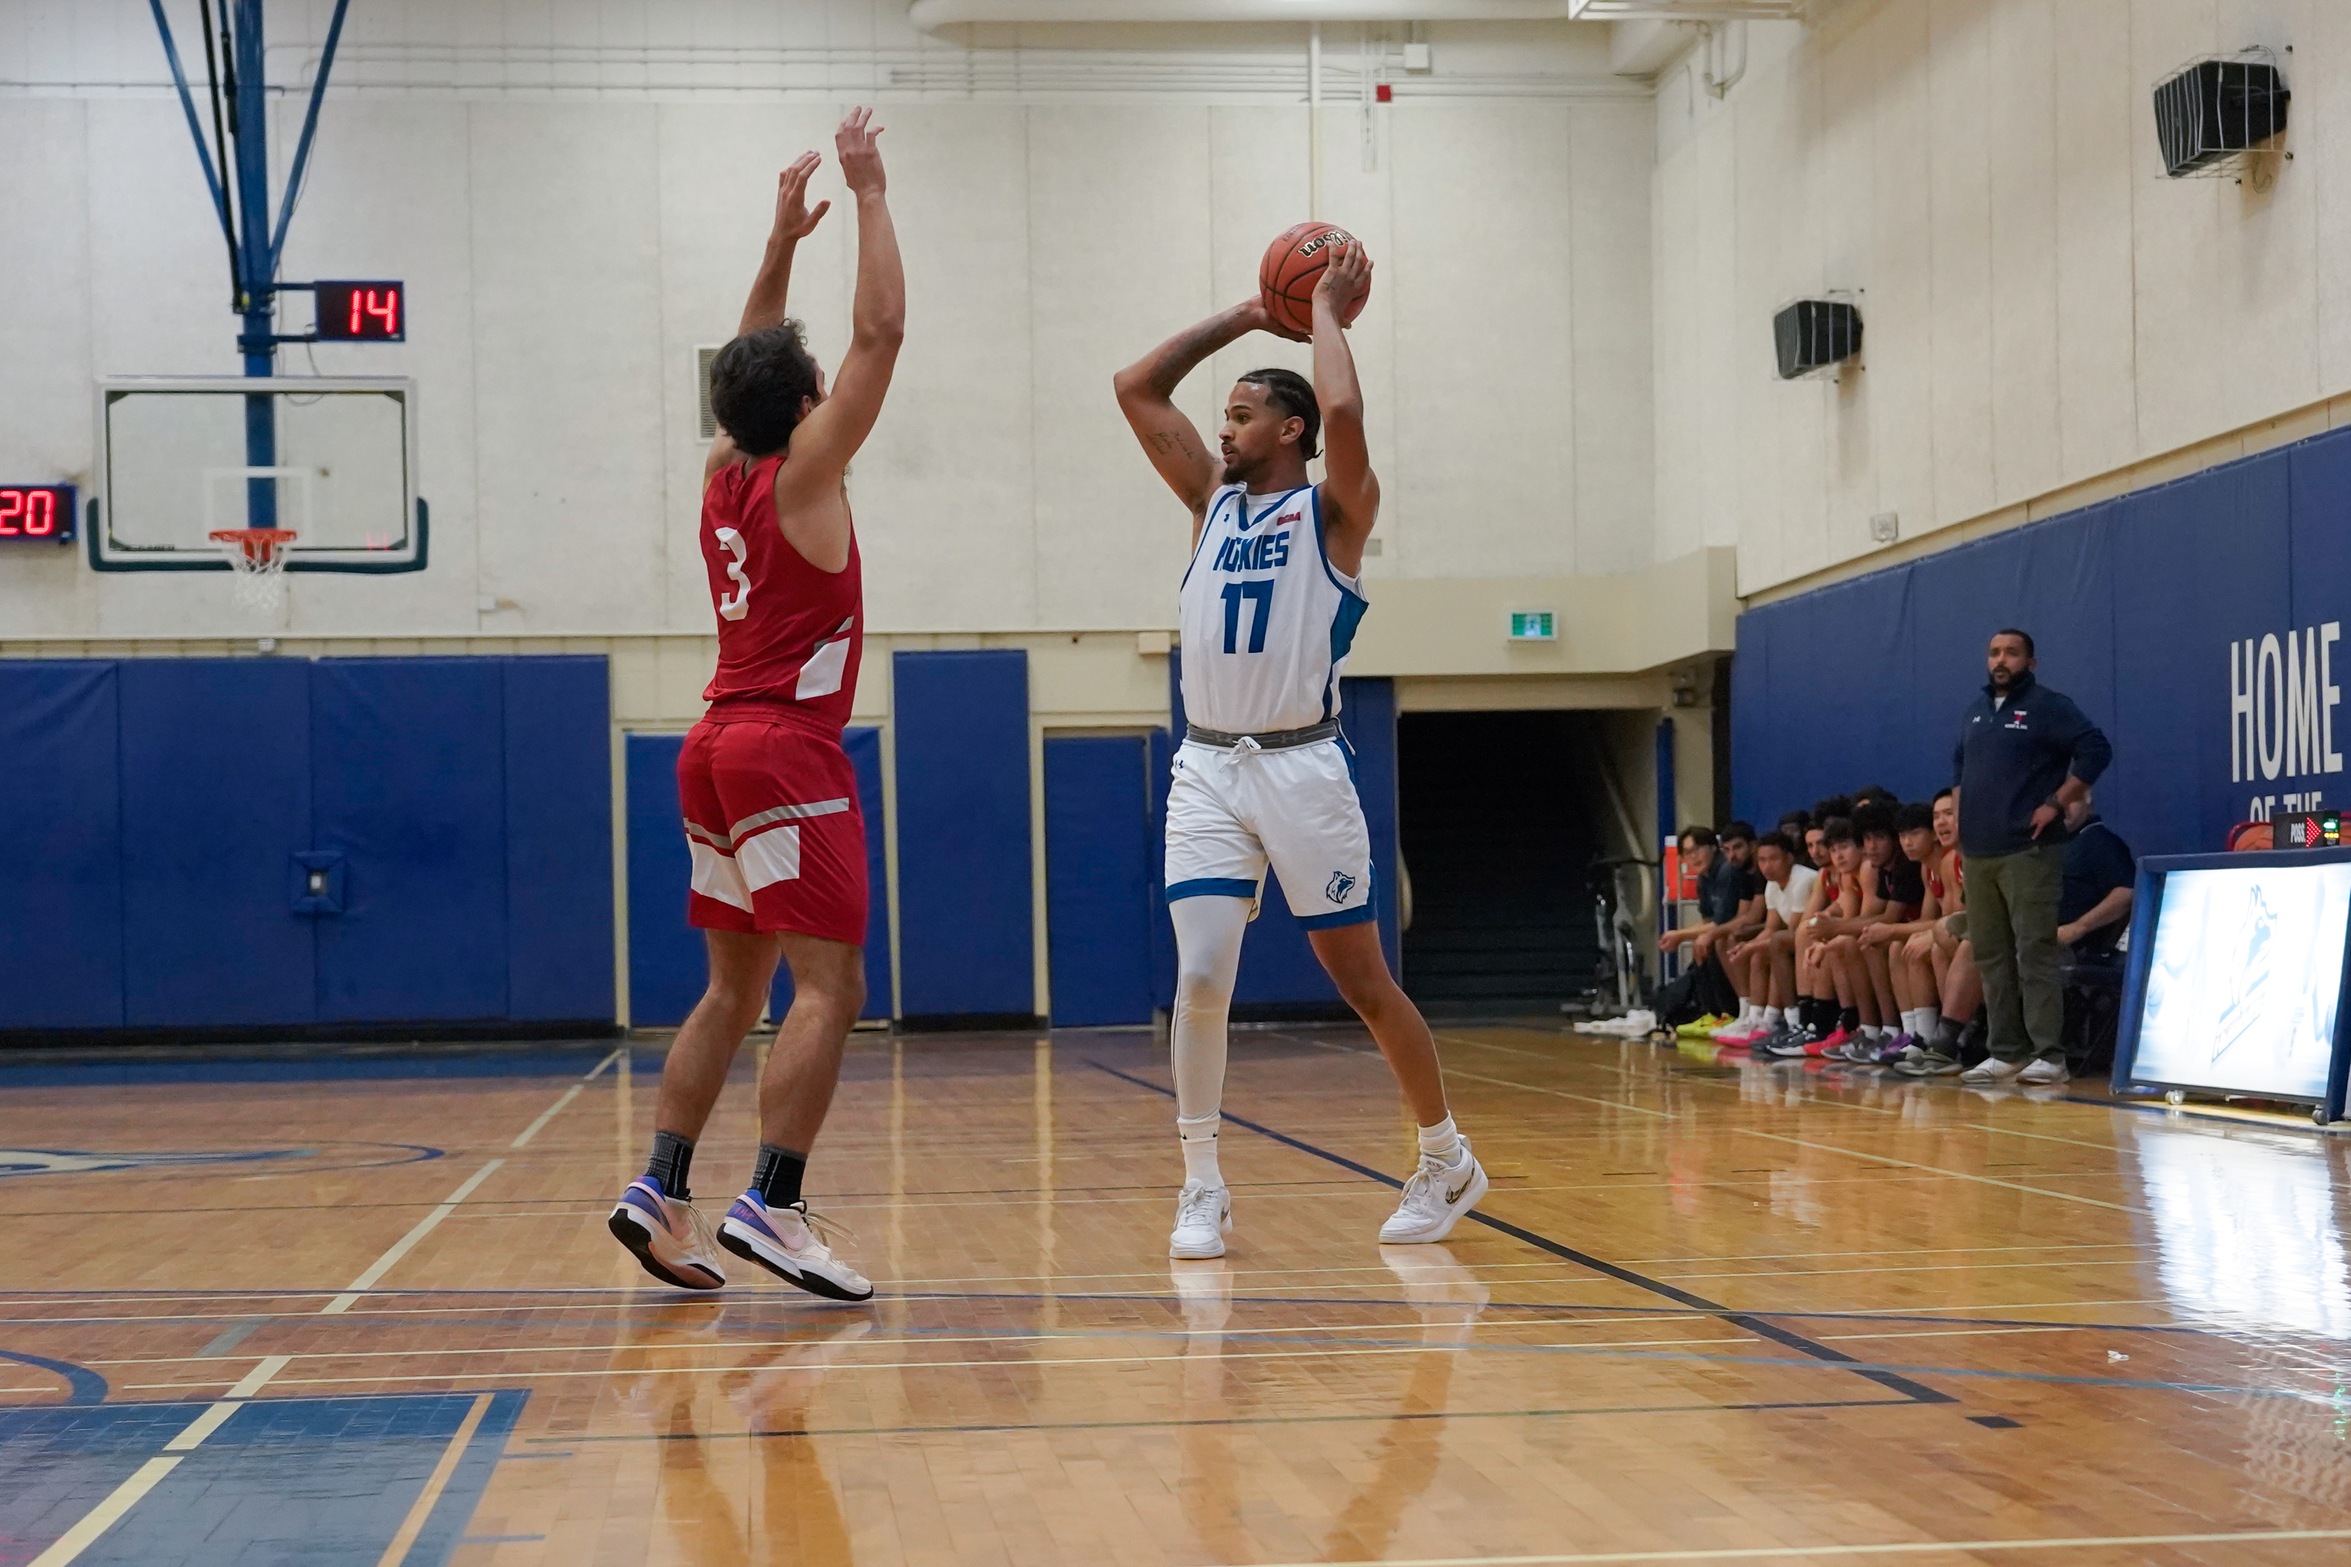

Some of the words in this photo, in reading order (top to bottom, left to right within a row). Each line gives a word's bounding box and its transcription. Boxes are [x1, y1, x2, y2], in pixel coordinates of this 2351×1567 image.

[1297, 230, 1356, 258] ilson
[350, 289, 397, 334] 14
[0, 489, 54, 535] 20
[715, 526, 751, 622] 3
[1220, 578, 1275, 655] 17
[2230, 620, 2343, 784] HOME
